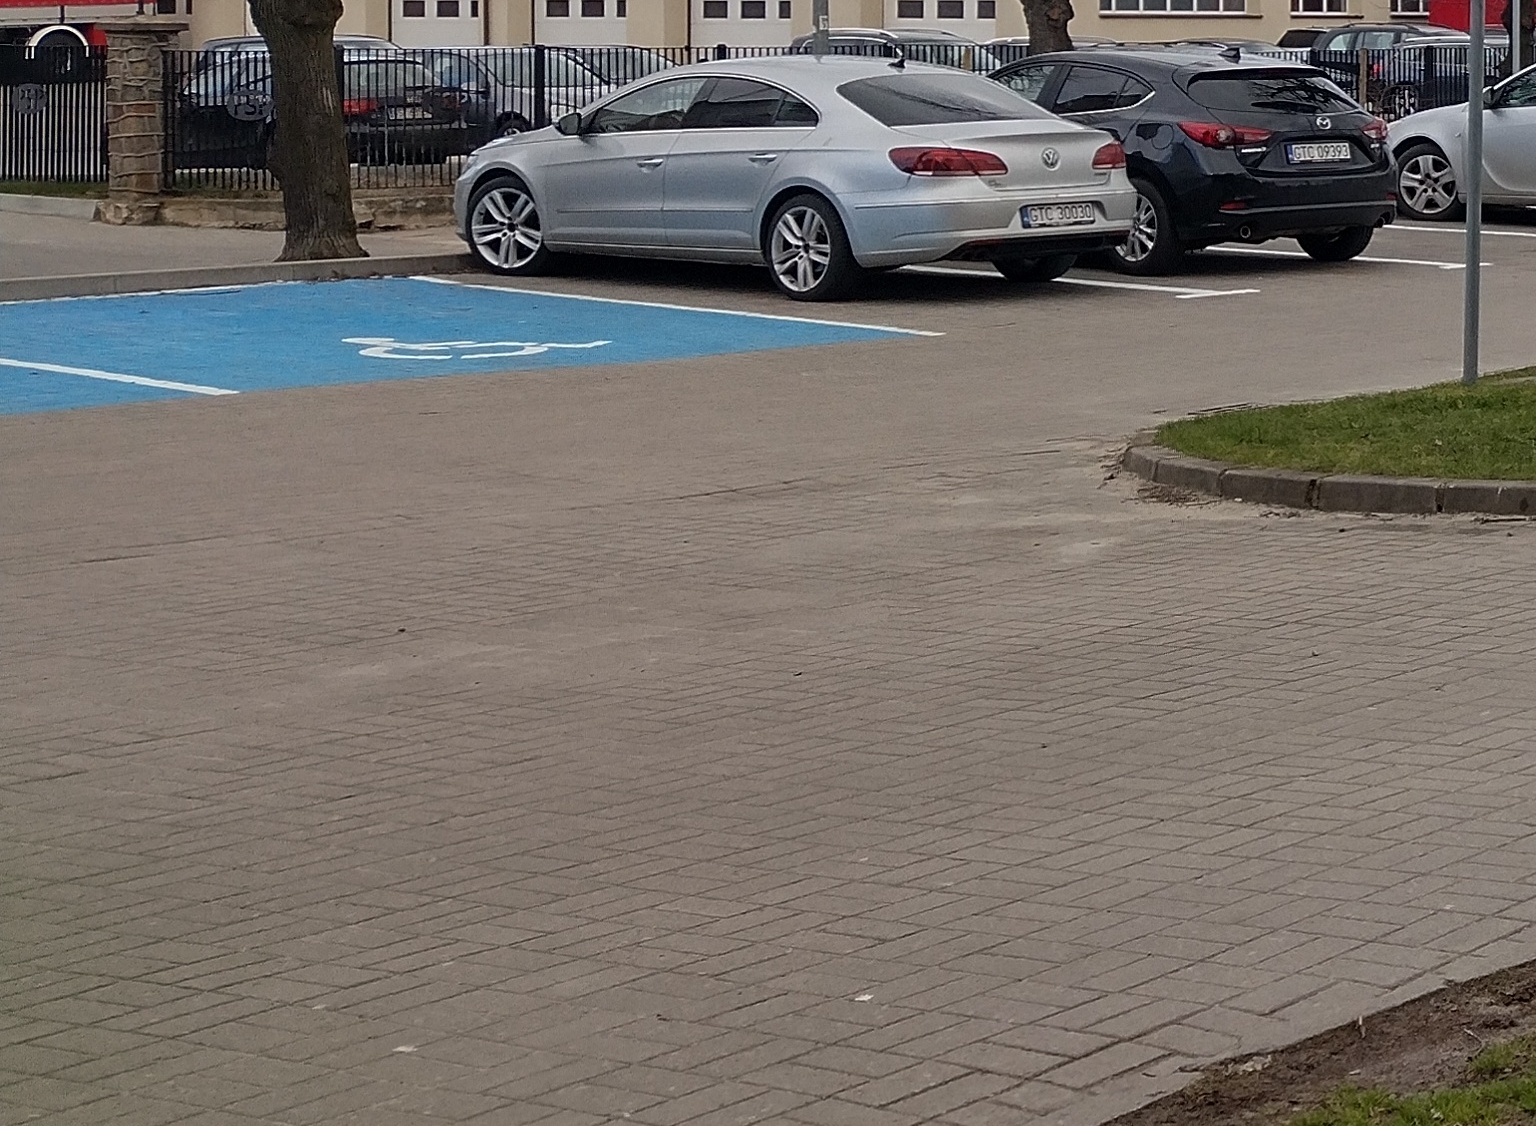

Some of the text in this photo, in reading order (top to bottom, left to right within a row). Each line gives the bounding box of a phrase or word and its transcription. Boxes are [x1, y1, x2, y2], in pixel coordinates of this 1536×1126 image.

[1294, 144, 1349, 160] GTC 09393
[1029, 204, 1092, 222] GTC 30030
